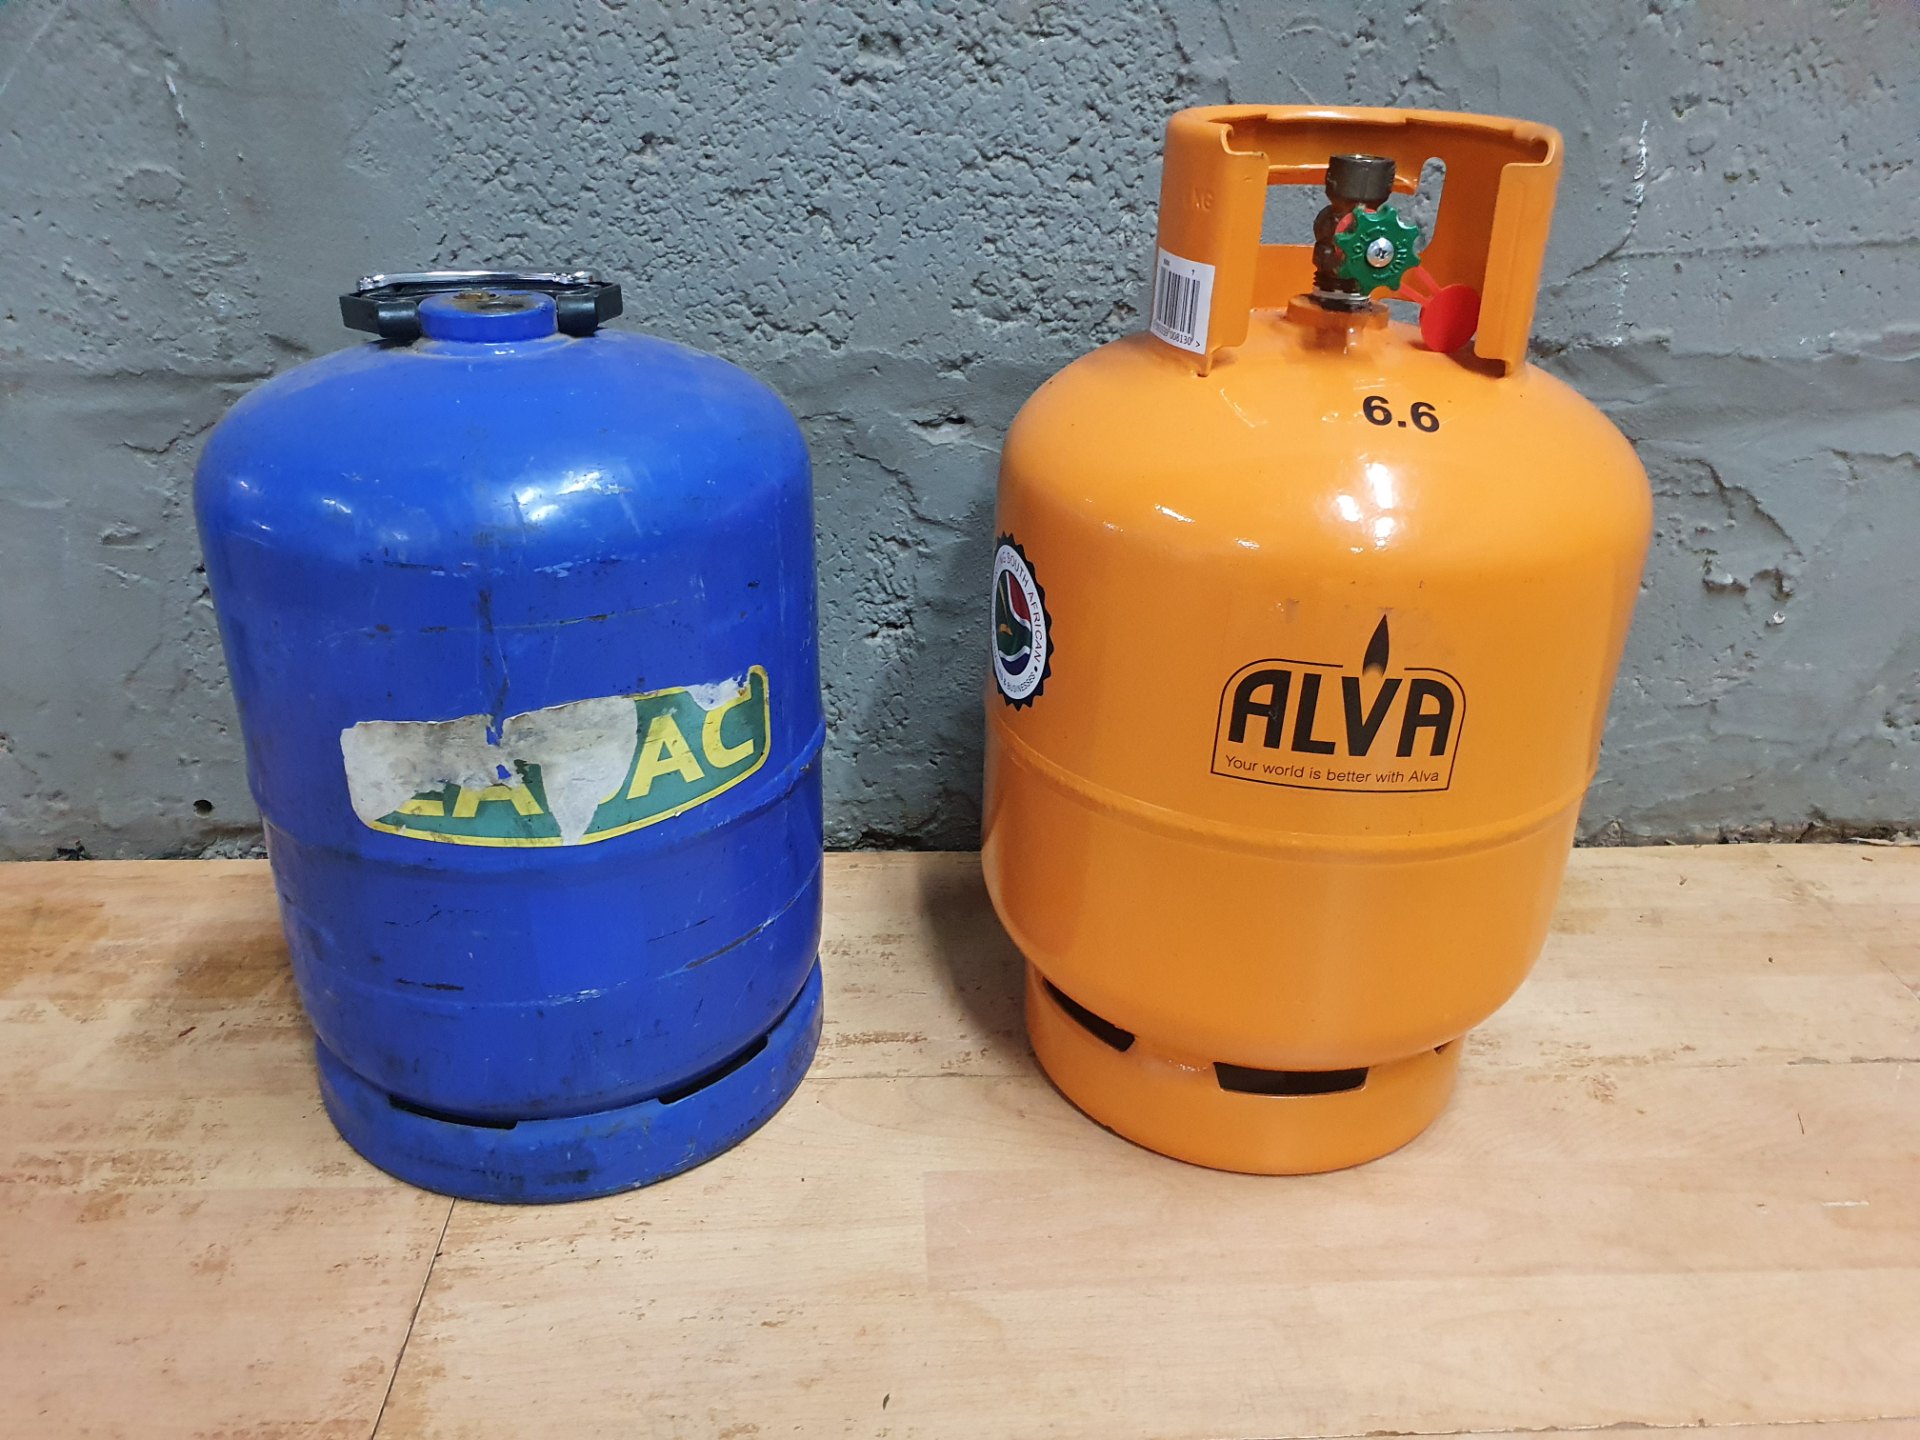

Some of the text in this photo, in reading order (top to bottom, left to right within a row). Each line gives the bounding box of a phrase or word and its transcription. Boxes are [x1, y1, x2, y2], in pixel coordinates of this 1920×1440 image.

[1362, 395, 1440, 433] 6.6
[1006, 551, 1043, 664] SOUTH AFRICAN
[1228, 668, 1455, 758] ALVA
[1224, 754, 1440, 783] Your world is better with Alva
